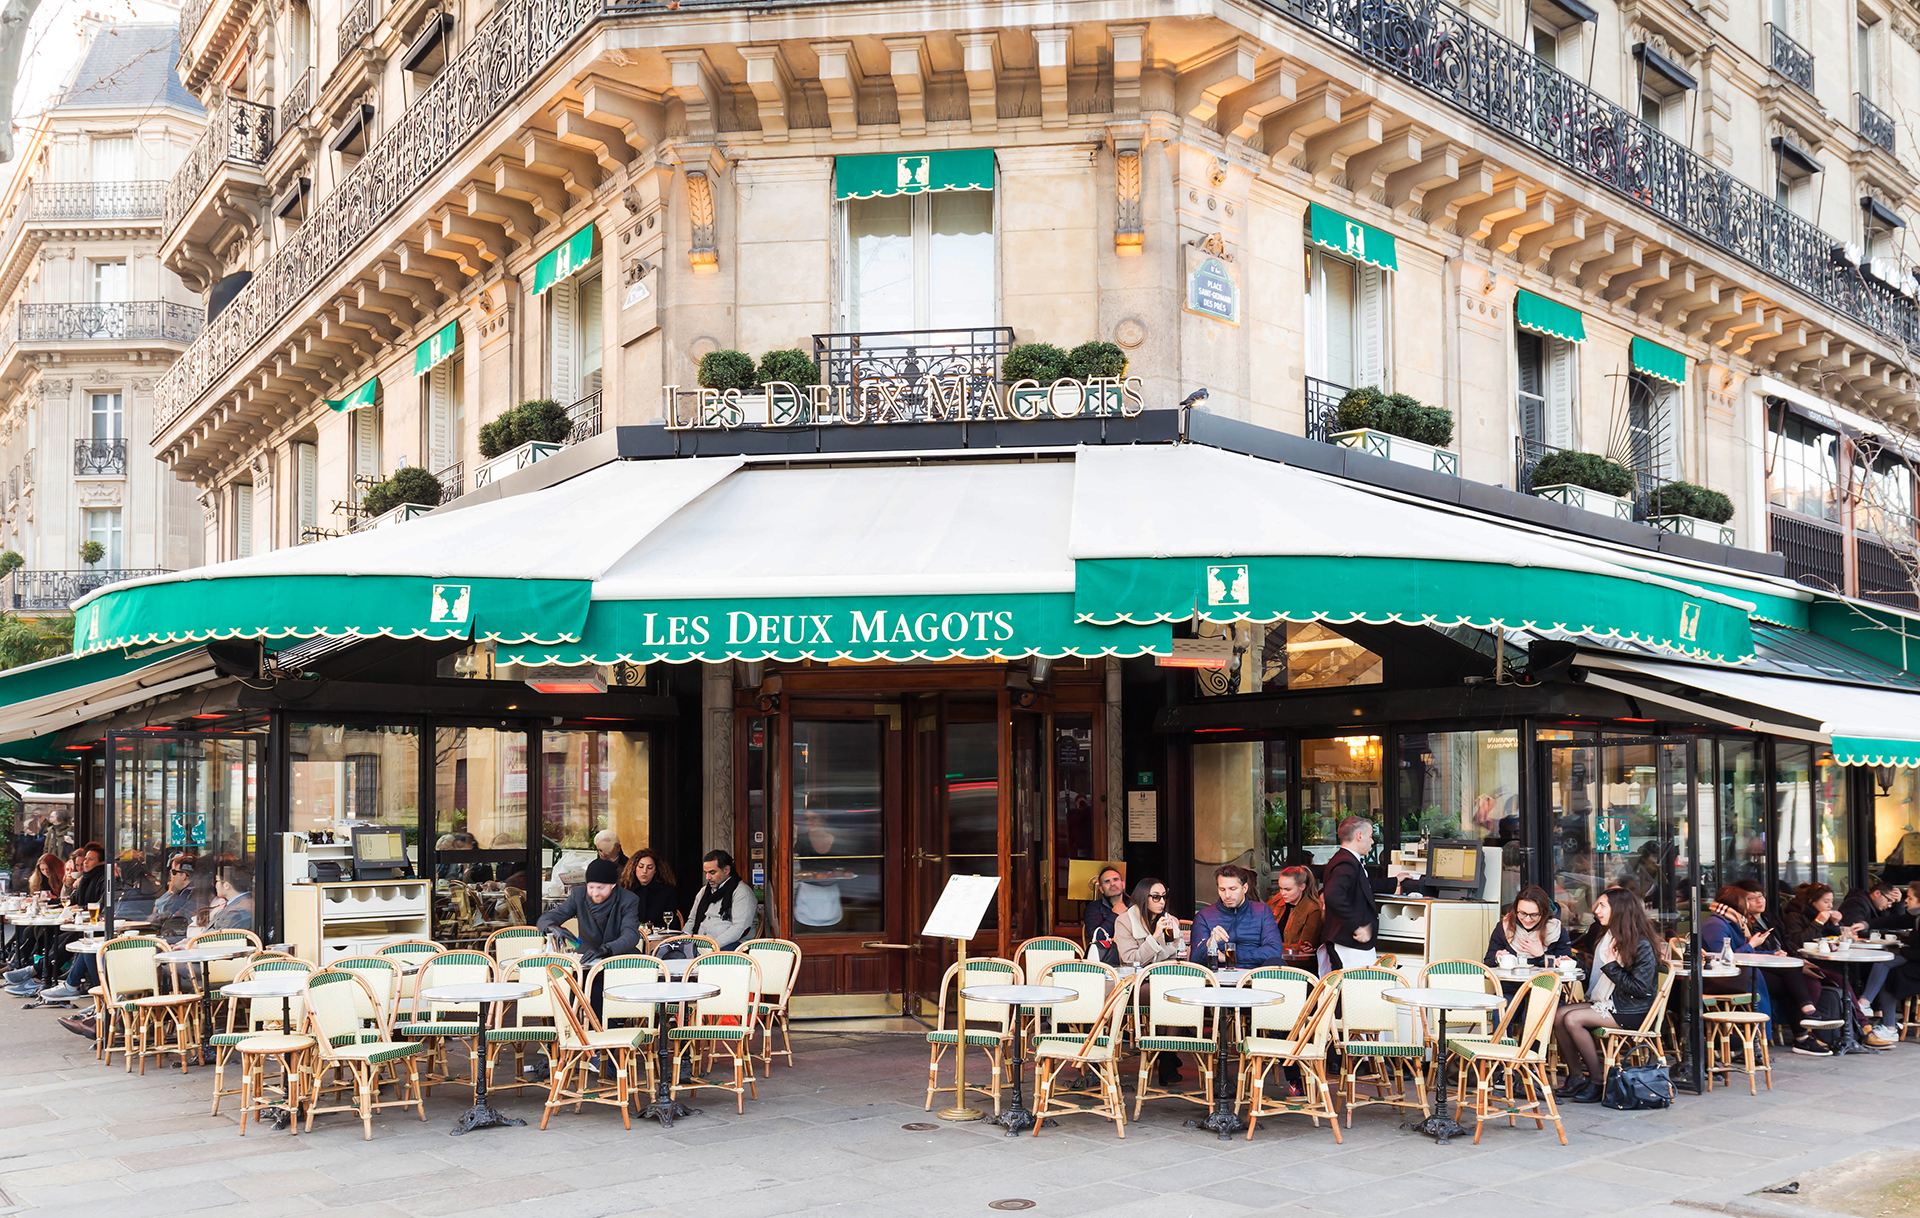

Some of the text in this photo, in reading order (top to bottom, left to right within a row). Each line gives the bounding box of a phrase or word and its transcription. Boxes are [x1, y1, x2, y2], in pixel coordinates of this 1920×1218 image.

[1207, 280, 1223, 291] PLACE
[1198, 287, 1231, 304] SAINT-GERMAIN
[1203, 299, 1213, 308] DES
[663, 374, 1144, 430] LES DEUX MAGOTS
[642, 610, 1014, 646] LES DEUX MAGOTS
